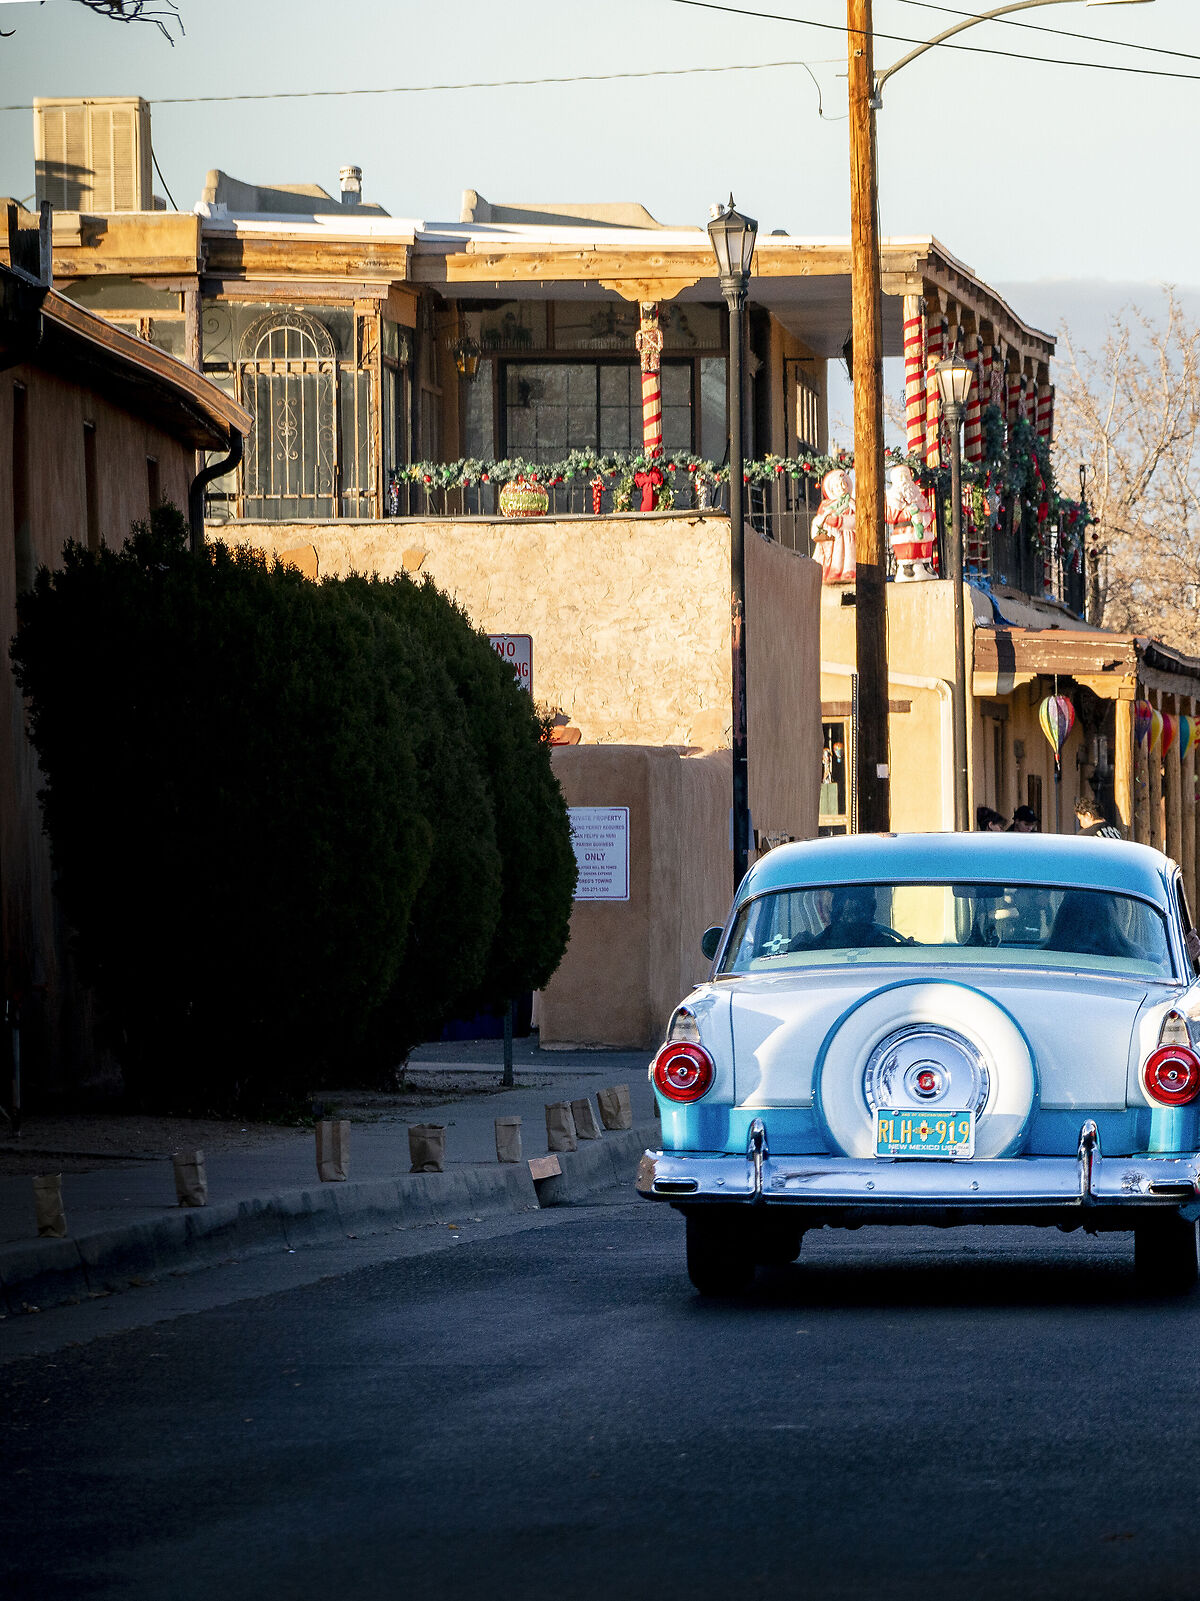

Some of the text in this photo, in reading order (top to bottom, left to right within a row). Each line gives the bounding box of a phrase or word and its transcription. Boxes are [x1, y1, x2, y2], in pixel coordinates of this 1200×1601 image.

[496, 641, 516, 657] NO
[584, 853, 606, 861] ONLY
[878, 1119, 969, 1144] RLH 919
